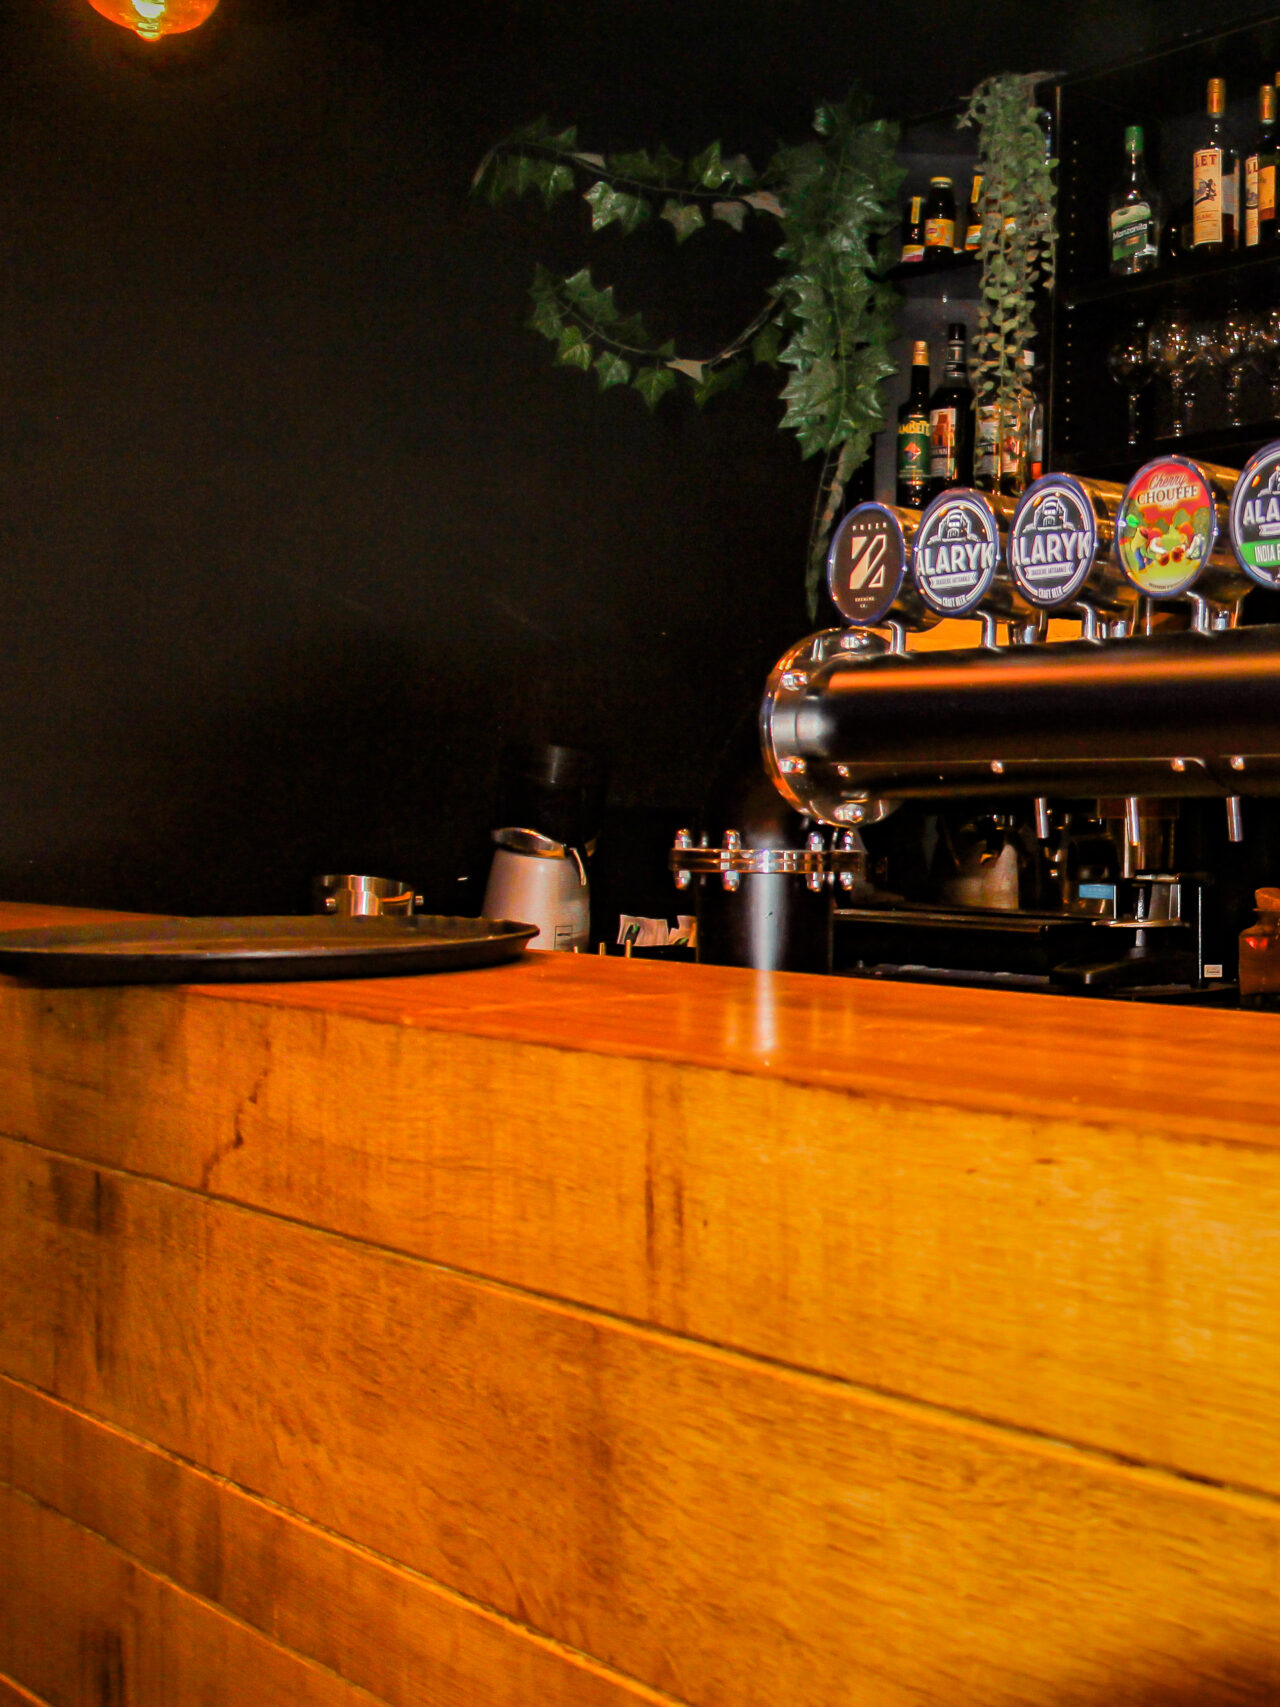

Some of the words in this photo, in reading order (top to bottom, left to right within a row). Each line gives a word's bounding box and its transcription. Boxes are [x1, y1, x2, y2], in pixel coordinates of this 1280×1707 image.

[1149, 473, 1186, 490] Cherry
[1137, 485, 1199, 505] CHOUFFE
[1012, 531, 1091, 566] ALARYK
[1254, 542, 1276, 562] INDIA
[916, 542, 995, 576] ALARYK
